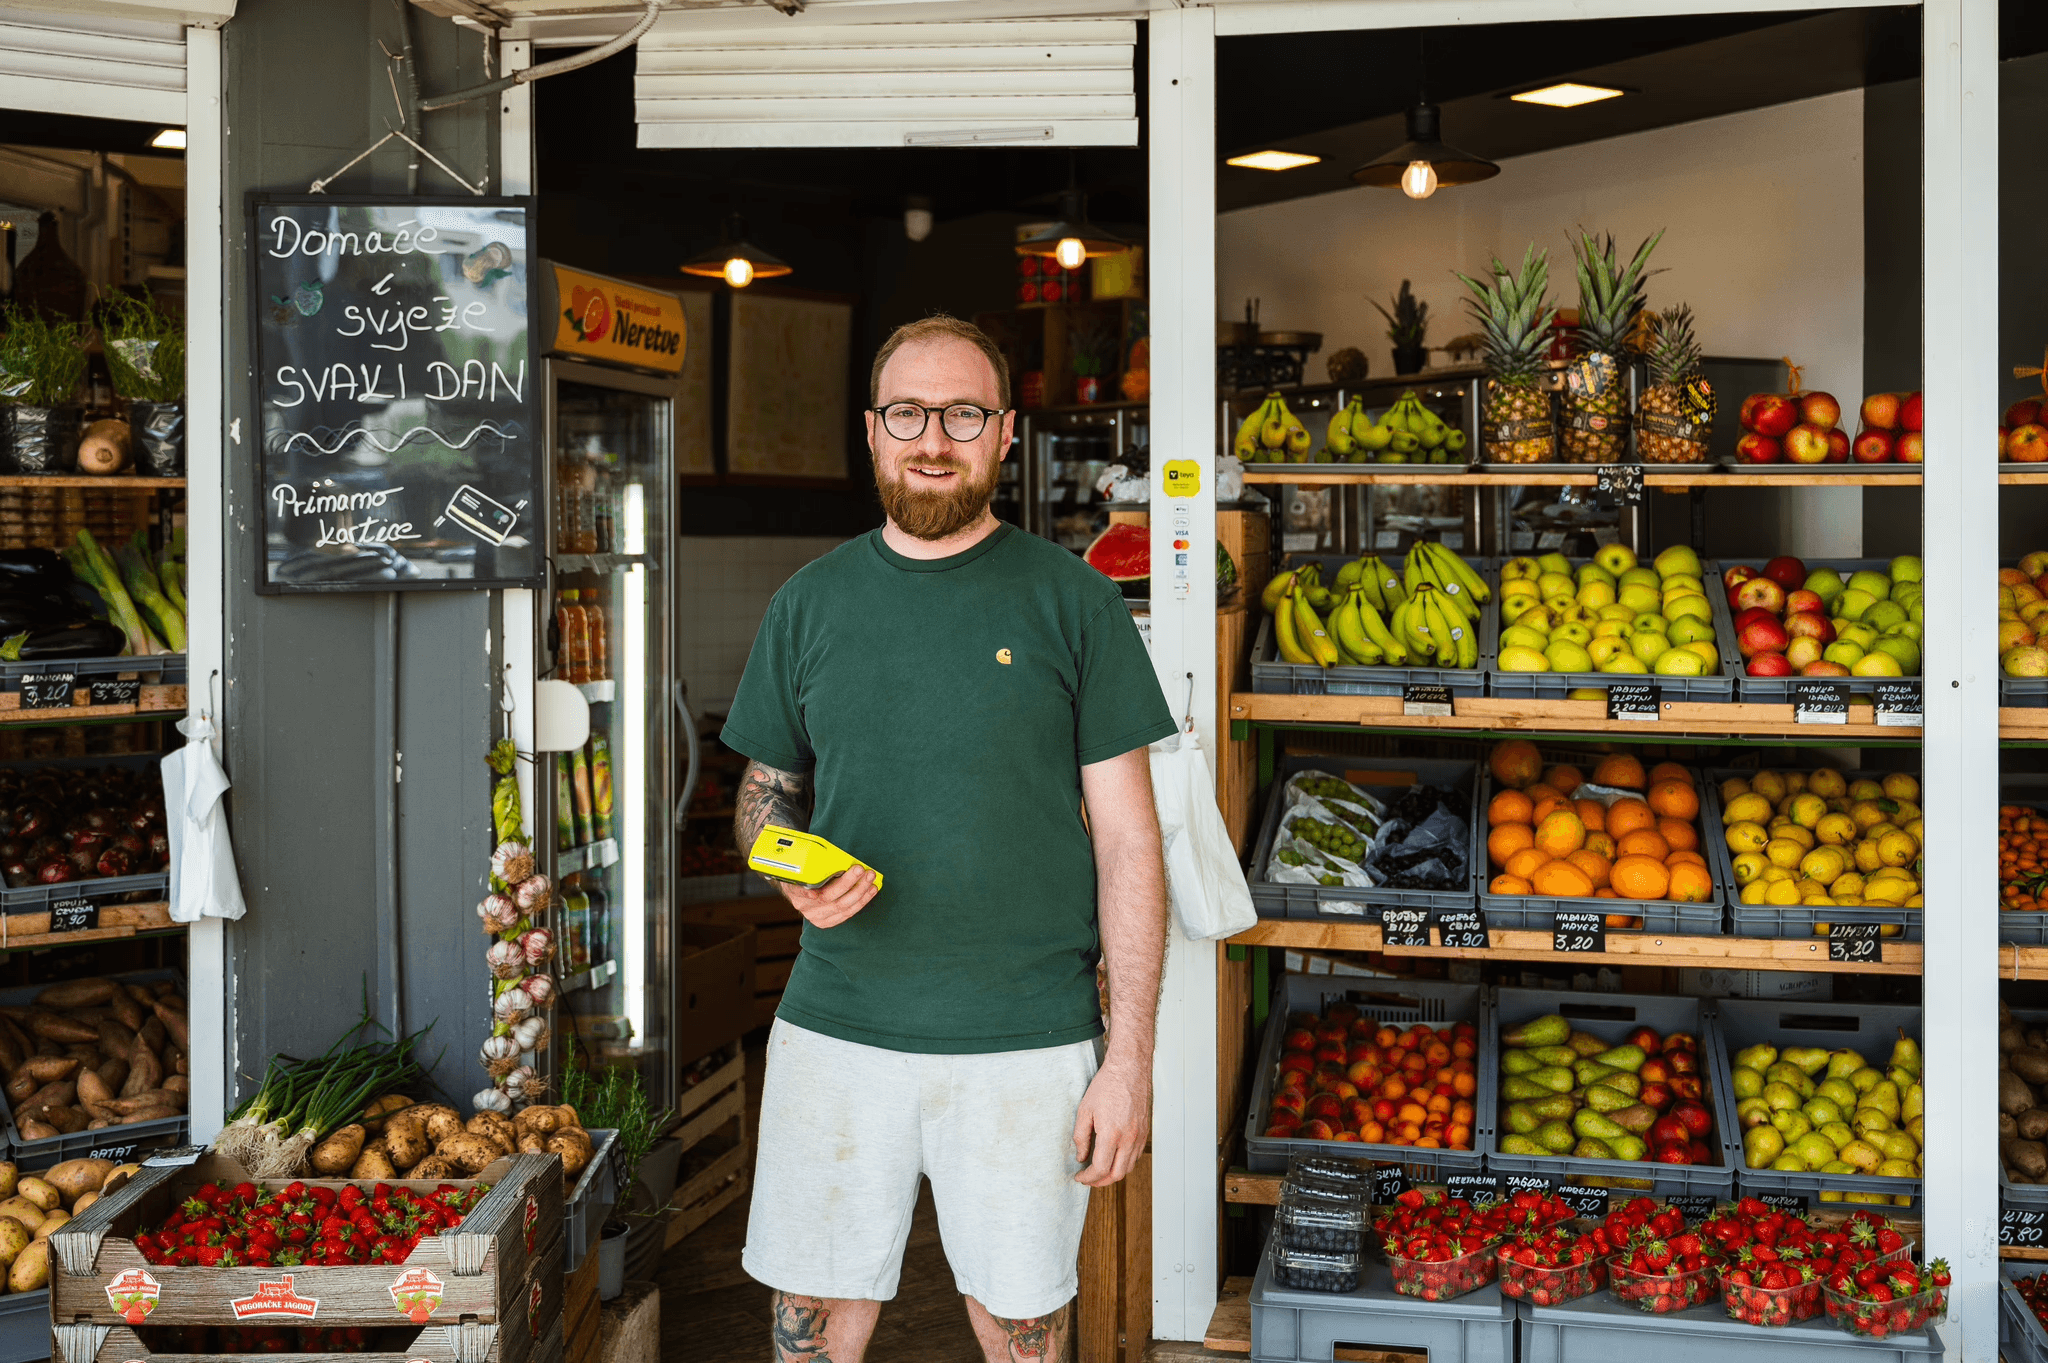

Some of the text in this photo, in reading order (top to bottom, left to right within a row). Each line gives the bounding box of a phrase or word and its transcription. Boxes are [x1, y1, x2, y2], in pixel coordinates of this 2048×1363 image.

[268, 215, 450, 259] Domaće
[337, 296, 496, 351] svježe
[612, 309, 681, 355] Neretve
[272, 358, 525, 407] SVAKI DAN
[1180, 471, 1194, 479] teyo
[272, 484, 404, 518] Primamo
[1877, 685, 1911, 693] JABUKA
[1882, 693, 1919, 705] GRANNY
[1388, 923, 1418, 932] BILO
[1561, 923, 1598, 932] MAYER
[1445, 932, 1484, 948] 5,90
[1556, 934, 1594, 951] 3,20
[1831, 940, 1875, 962] 3,20
[1447, 1176, 1497, 1186] NEKTARINA
[1506, 1176, 1551, 1189] JAGODA
[1558, 1186, 1608, 1197] MARELICA
[2002, 1210, 2045, 1224] KIWI
[1998, 1226, 2042, 1245] 5,80
[237, 1300, 314, 1313] VRGORAČKE JAGODE
